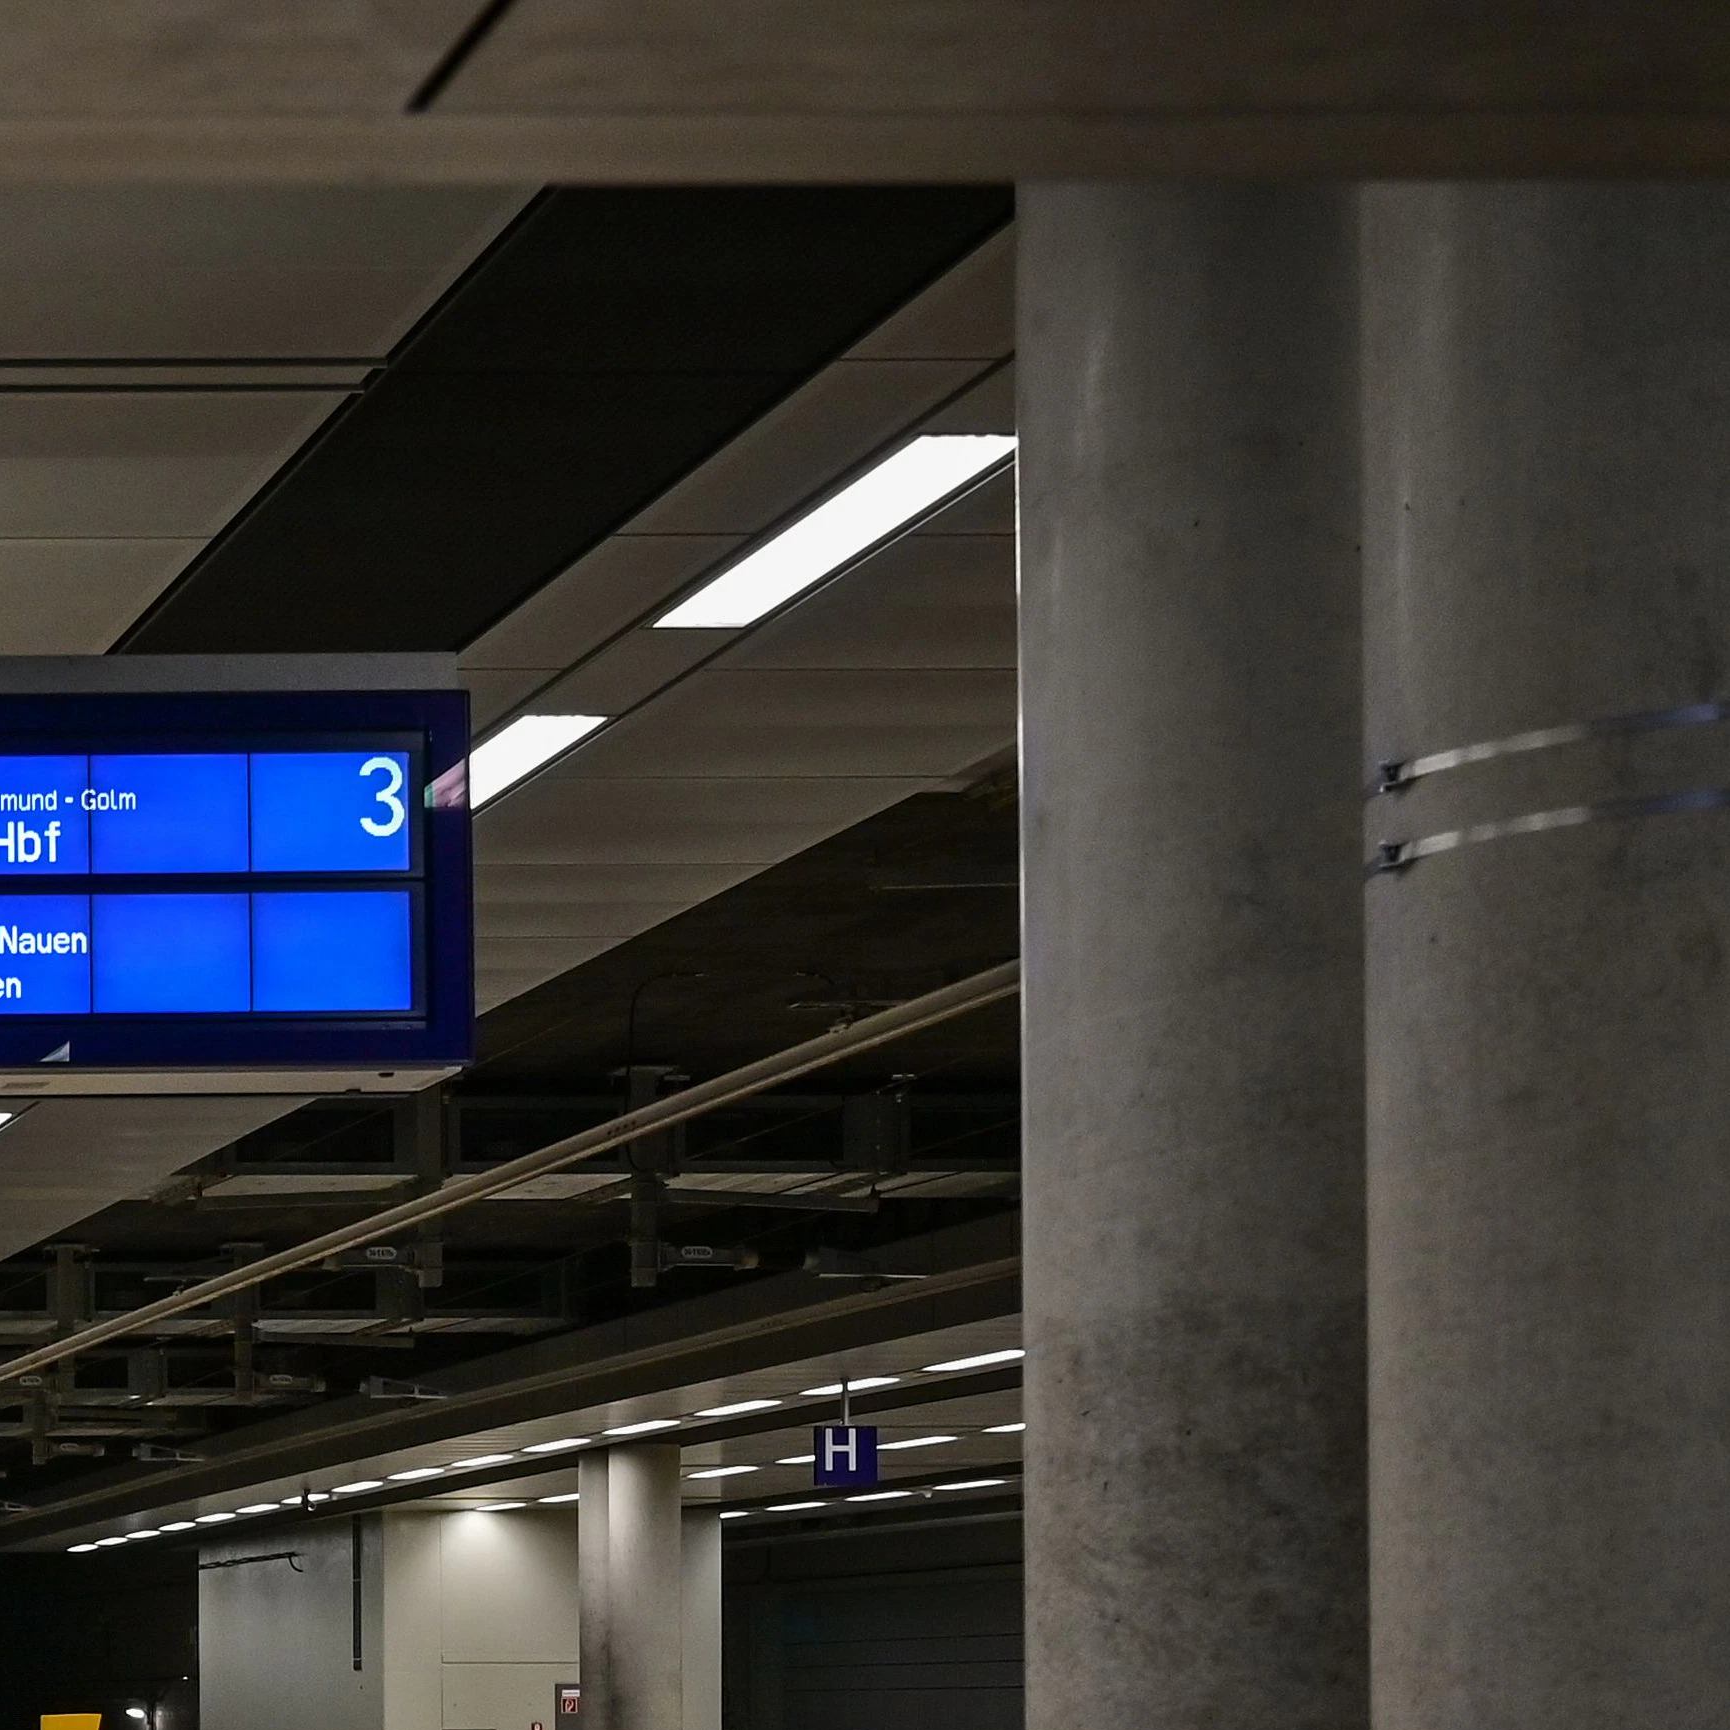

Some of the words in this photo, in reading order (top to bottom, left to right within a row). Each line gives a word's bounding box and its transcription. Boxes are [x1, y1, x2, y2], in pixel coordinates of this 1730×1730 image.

[81, 788, 136, 811] Golm
[359, 757, 405, 837] 3
[825, 1428, 857, 1472] H
